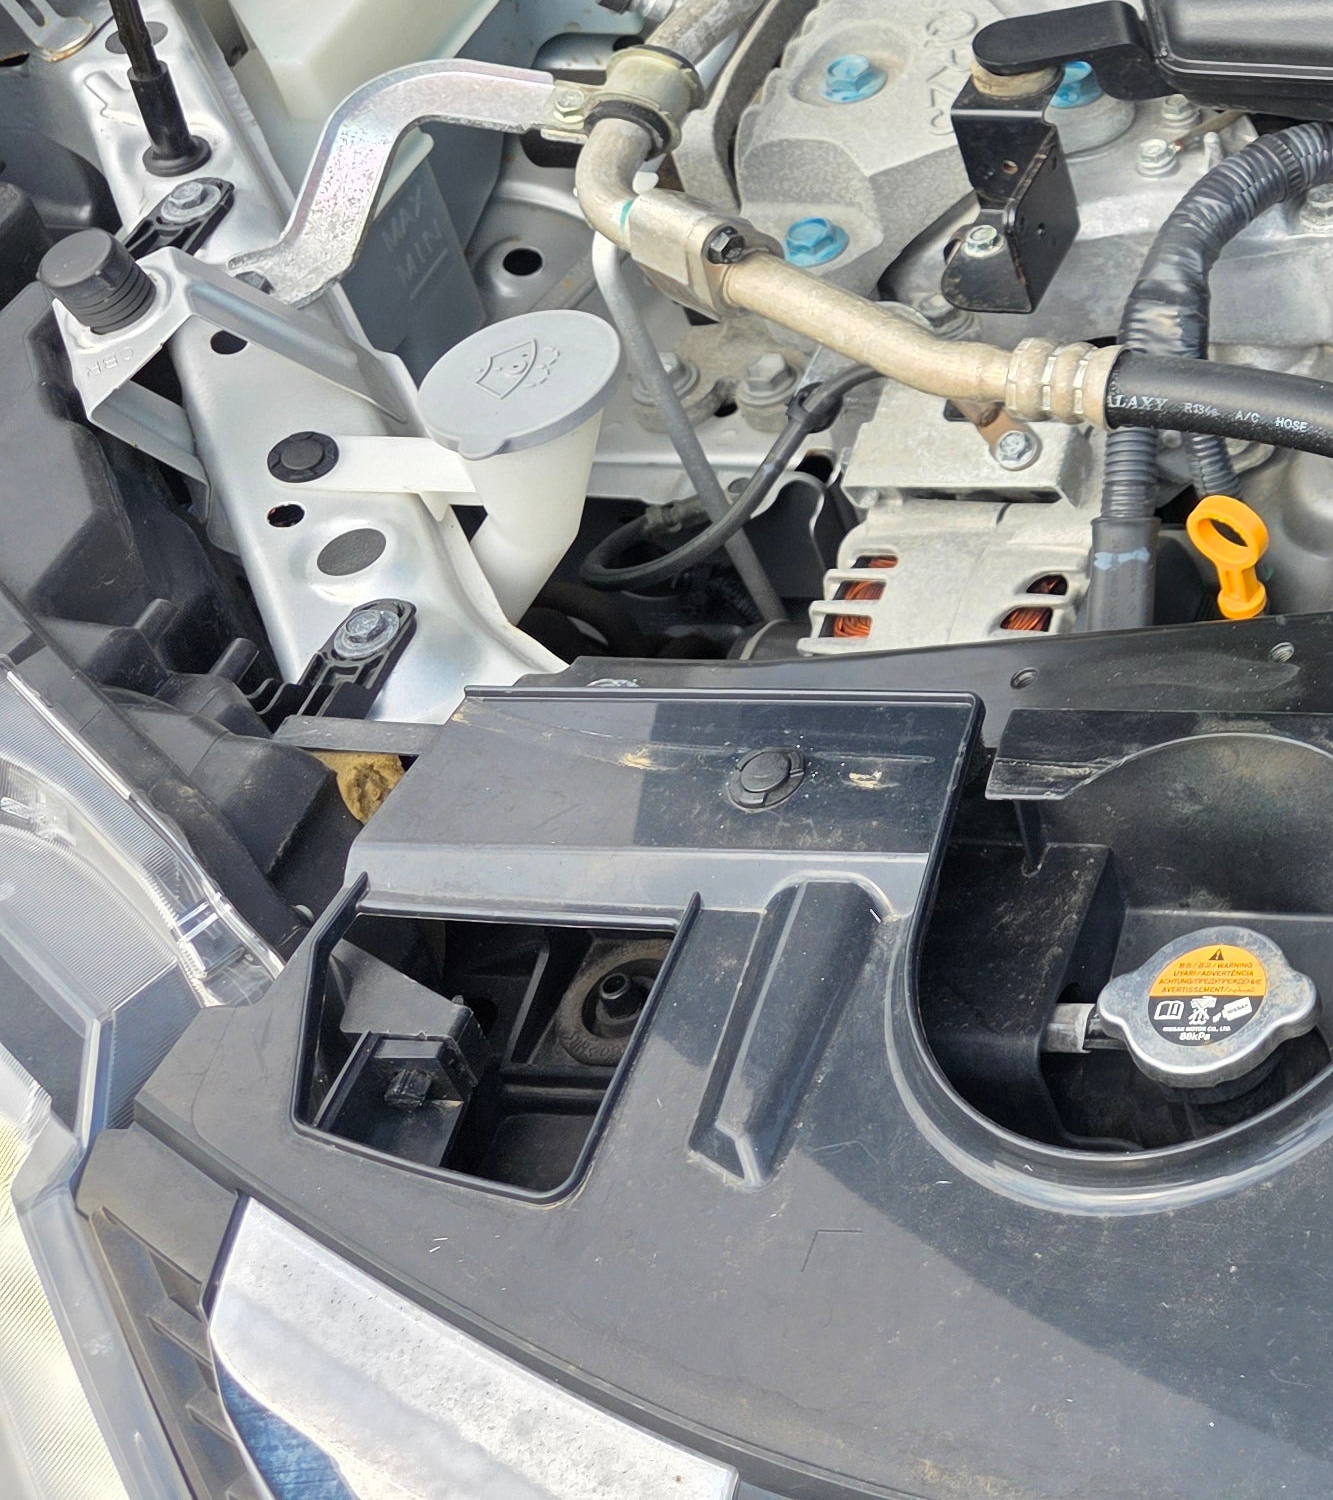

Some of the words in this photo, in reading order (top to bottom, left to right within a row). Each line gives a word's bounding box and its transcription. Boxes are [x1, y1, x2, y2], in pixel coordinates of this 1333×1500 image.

[381, 183, 429, 254] MAX
[396, 217, 443, 289] MIN
[1235, 410, 1260, 423] A/C
[1275, 416, 1309, 433] HOSE
